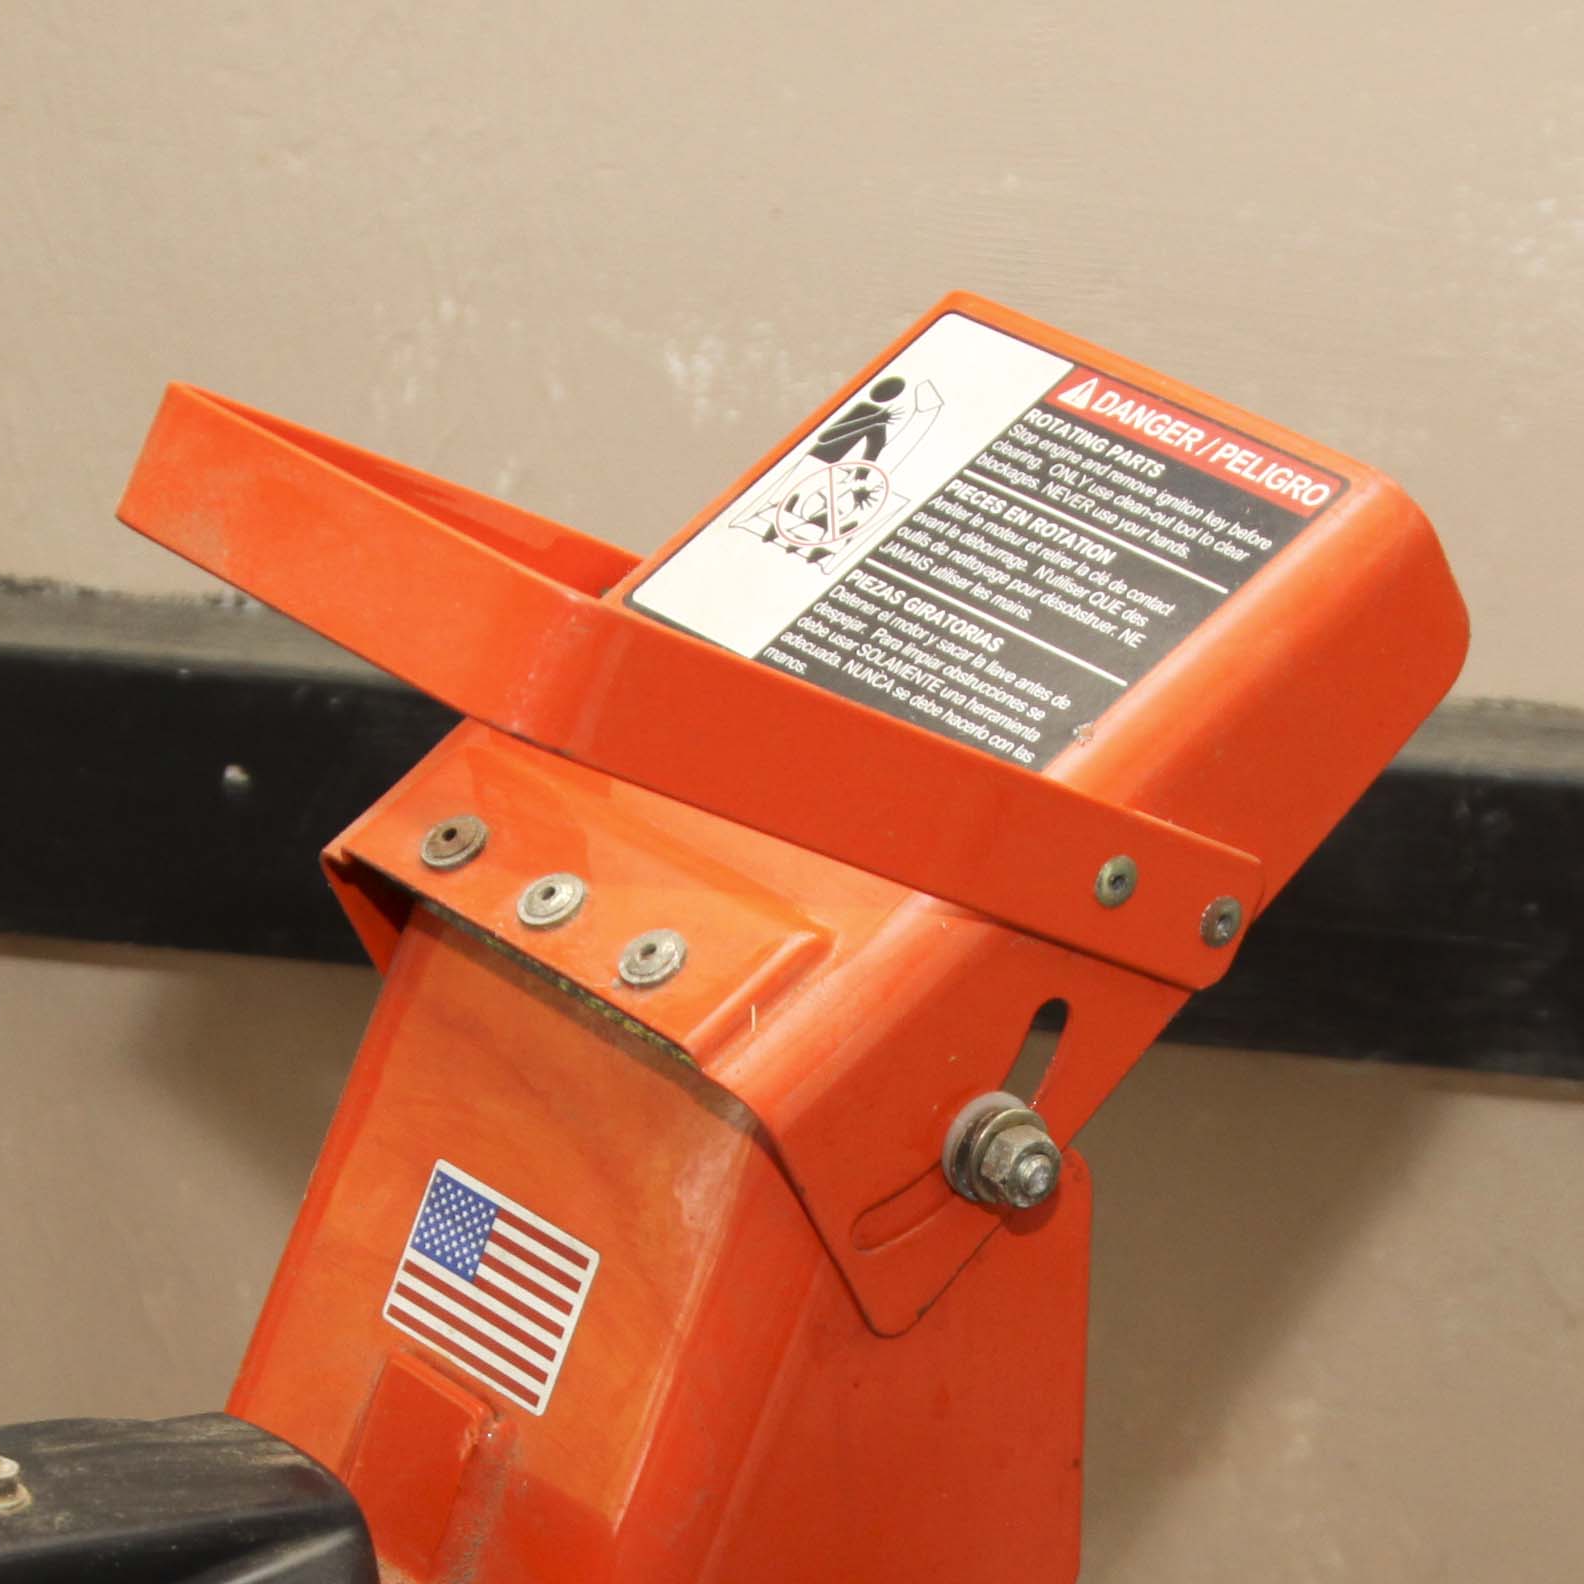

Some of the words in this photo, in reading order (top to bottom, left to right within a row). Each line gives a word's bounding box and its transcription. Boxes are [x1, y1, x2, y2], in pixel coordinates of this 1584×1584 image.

[989, 438, 1046, 471] clearing.
[1046, 462, 1094, 490] ONLY
[1085, 481, 1117, 502] use
[1110, 493, 1178, 530] clean-out
[1169, 518, 1204, 540] tool
[1195, 530, 1217, 548] to
[1210, 538, 1252, 563] clear
[1005, 422, 1042, 446] Stop
[1036, 438, 1085, 466] engine
[1078, 456, 1113, 478] and
[1104, 468, 1160, 499] remove
[1152, 489, 1207, 520] ignition
[1200, 510, 1232, 533] key
[1225, 521, 1275, 552] before
[1022, 406, 1111, 453] ROTATING
[1104, 444, 1167, 478] PARTS
[1090, 389, 1208, 452] DANGER
[1195, 439, 1220, 461] /
[1208, 442, 1333, 508] PELIGRO
[926, 494, 975, 522] Arrêter
[967, 512, 986, 528] le
[980, 520, 1030, 548] moteur
[1023, 540, 1044, 554] et
[1036, 546, 1080, 570] retirer
[1072, 561, 1093, 577] la
[1086, 568, 1113, 586] clé
[1106, 577, 1130, 595] de
[1124, 586, 1178, 616] contact
[943, 478, 1009, 515] PIECES
[1001, 505, 1034, 526] EN
[1026, 516, 1118, 565] ROTATION
[972, 451, 1044, 492] blockages.
[1038, 480, 1097, 514] NEVER
[1089, 505, 1121, 526] use
[1112, 516, 1153, 540] your
[1144, 528, 1194, 560] hands.
[843, 568, 908, 606] PIEZAS
[901, 596, 1006, 652] GIRATORIAS
[876, 540, 935, 572] JAMAIS
[928, 563, 976, 592] utiliser
[967, 581, 995, 601] les
[988, 592, 1036, 622] mains.
[894, 524, 934, 549] outils
[926, 539, 952, 557] de
[944, 548, 1013, 586] nettoyage
[1004, 576, 1045, 600] pour
[1036, 590, 1122, 638] désobstruer.
[1116, 626, 1148, 649] NE
[909, 510, 952, 535] avant
[942, 524, 963, 540] le
[956, 530, 1032, 574] débourrage.
[1030, 564, 1092, 600] N'utiliser
[1086, 590, 1127, 616] QUE
[1118, 606, 1152, 628] des
[762, 646, 810, 674] manos.
[778, 630, 844, 669] adecuada.
[840, 660, 897, 694] NUNCA
[890, 685, 913, 702] se
[906, 694, 946, 718] debe
[940, 708, 992, 741] hacerlo
[986, 732, 1017, 753] con
[1010, 744, 1038, 764] las
[794, 614, 832, 639] debe
[824, 630, 862, 652] usar
[854, 643, 946, 694] SOLAMENTE
[937, 684, 970, 706] una
[962, 696, 1044, 743] herramienta
[810, 600, 871, 636] despejar.
[868, 627, 906, 652] Para
[898, 641, 948, 672] limpiar
[940, 663, 1032, 713] obstrucciones
[1024, 704, 1050, 722] se
[826, 584, 882, 617] Detener
[874, 608, 896, 624] el
[888, 615, 932, 640] motor
[933, 637, 976, 663] sacar
[968, 653, 989, 670] la
[982, 660, 1019, 684] llave
[1012, 676, 1056, 702] antes
[1048, 692, 1074, 711] de
